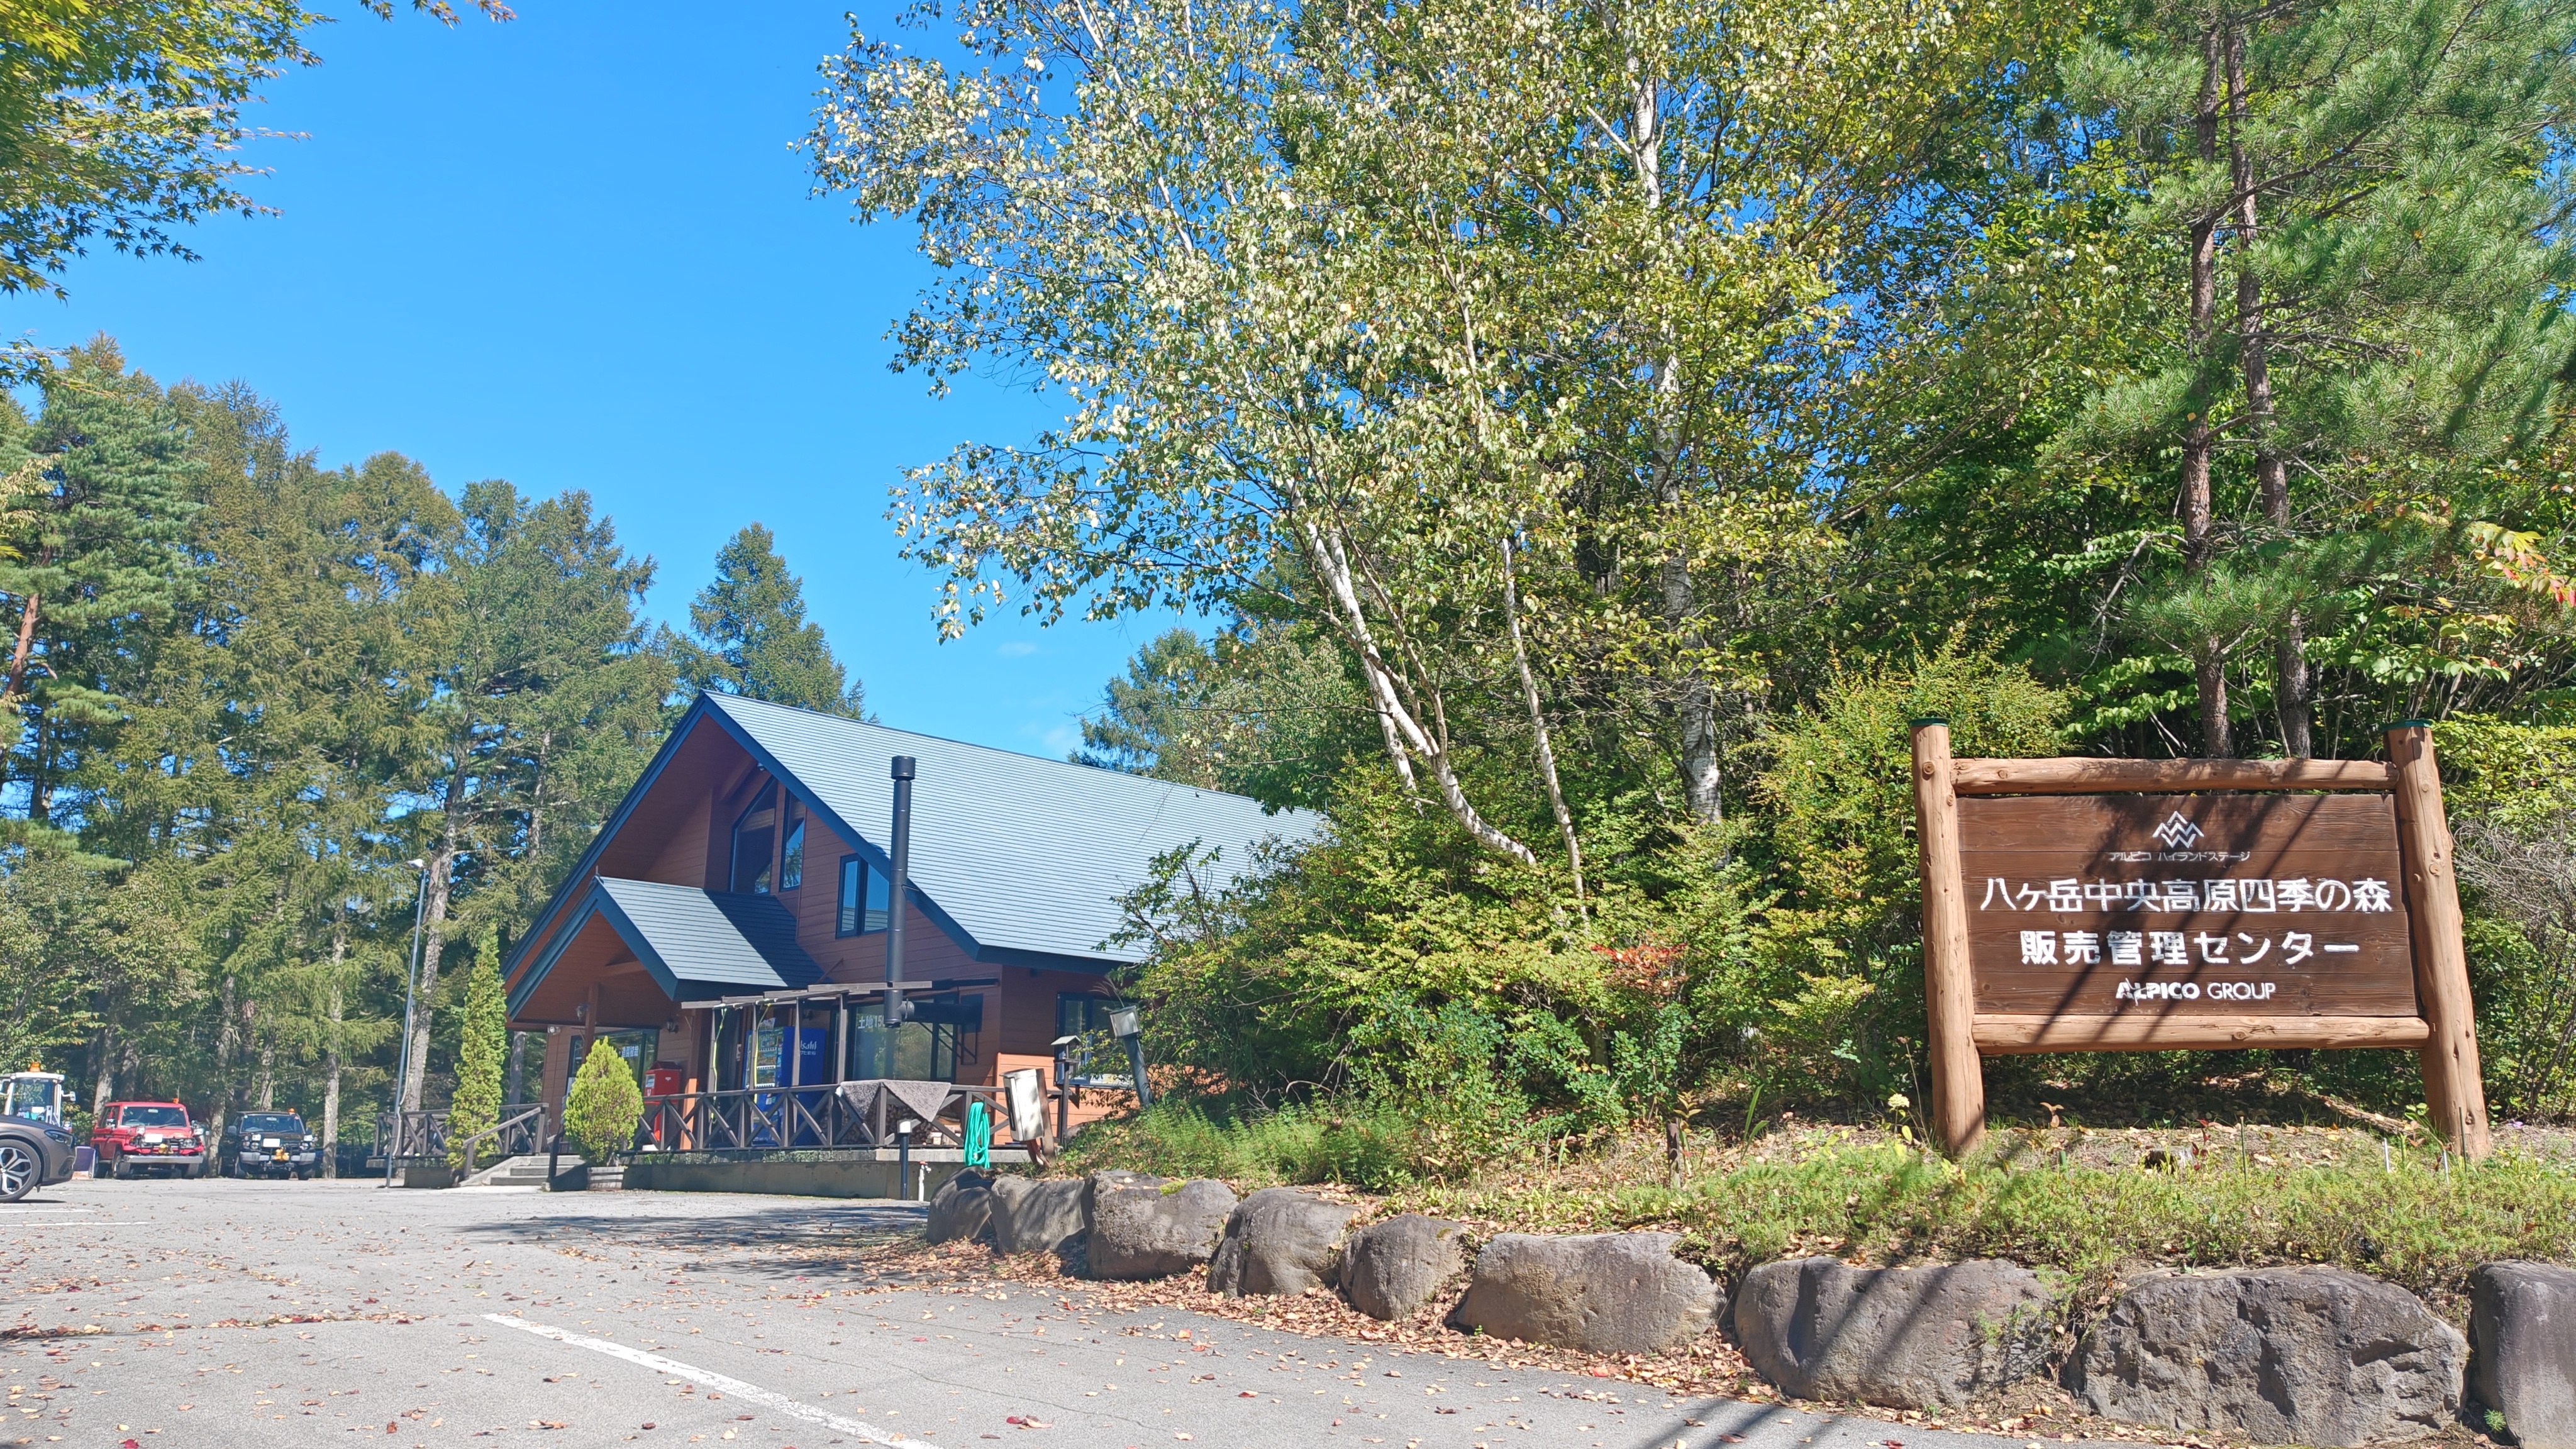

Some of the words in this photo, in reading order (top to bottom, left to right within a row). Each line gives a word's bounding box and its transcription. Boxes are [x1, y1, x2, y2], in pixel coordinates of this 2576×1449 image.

[2109, 852, 2152, 862] アルピコ
[2158, 851, 2251, 862] ハイランドステージ
[2020, 931, 2359, 965] 販売管理センター
[2116, 978, 2200, 1006] ALPICO
[2207, 982, 2276, 1000] GROUP
